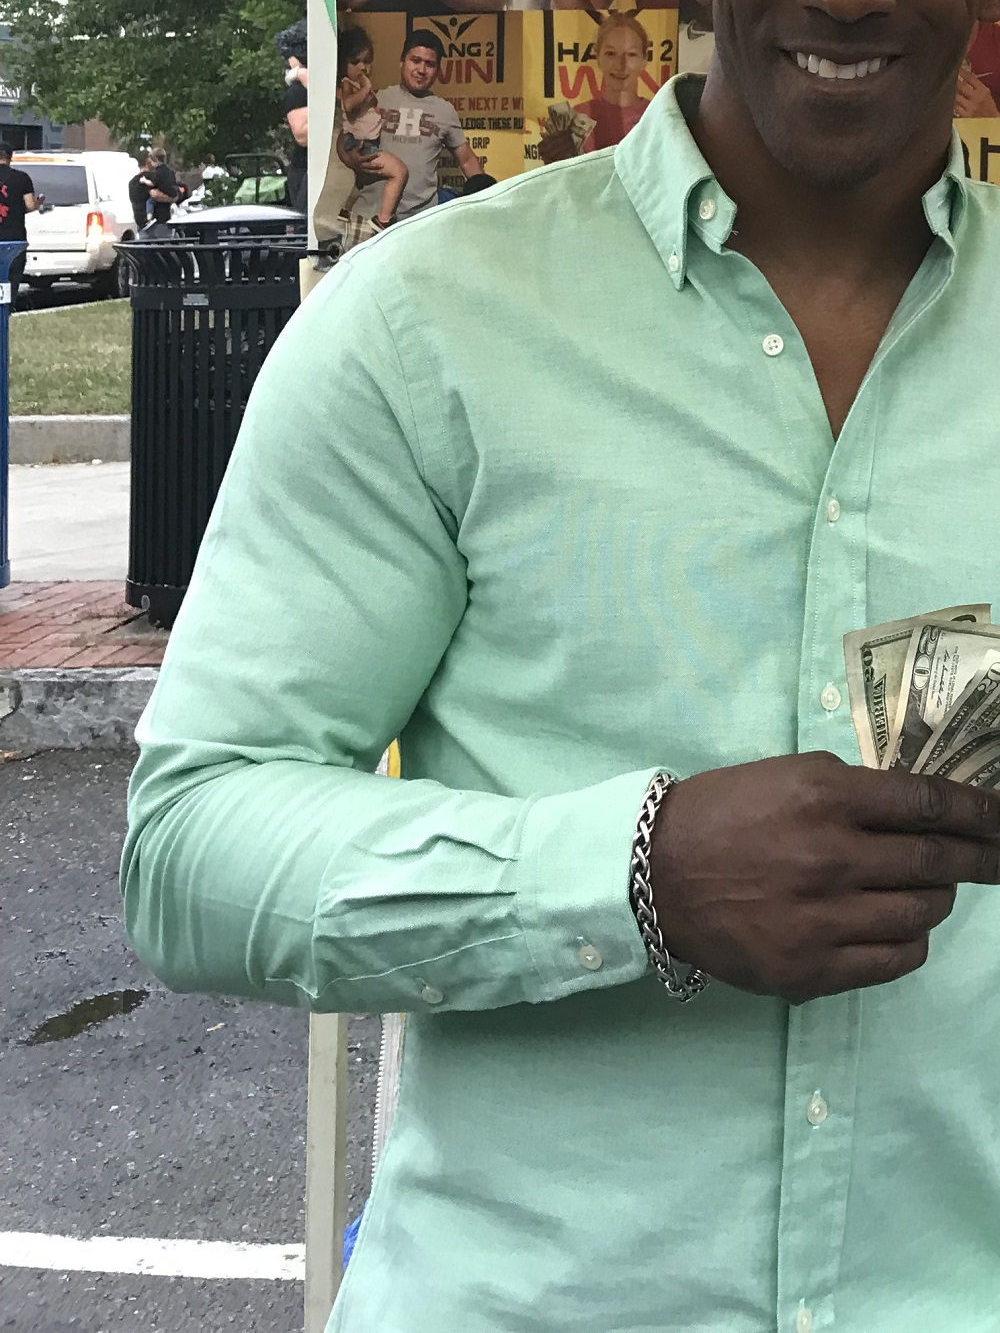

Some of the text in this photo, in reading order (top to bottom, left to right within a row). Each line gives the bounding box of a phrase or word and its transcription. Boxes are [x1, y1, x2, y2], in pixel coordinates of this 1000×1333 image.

[486, 41, 495, 57] 2
[469, 97, 498, 111] NEXT
[501, 98, 509, 111] 2
